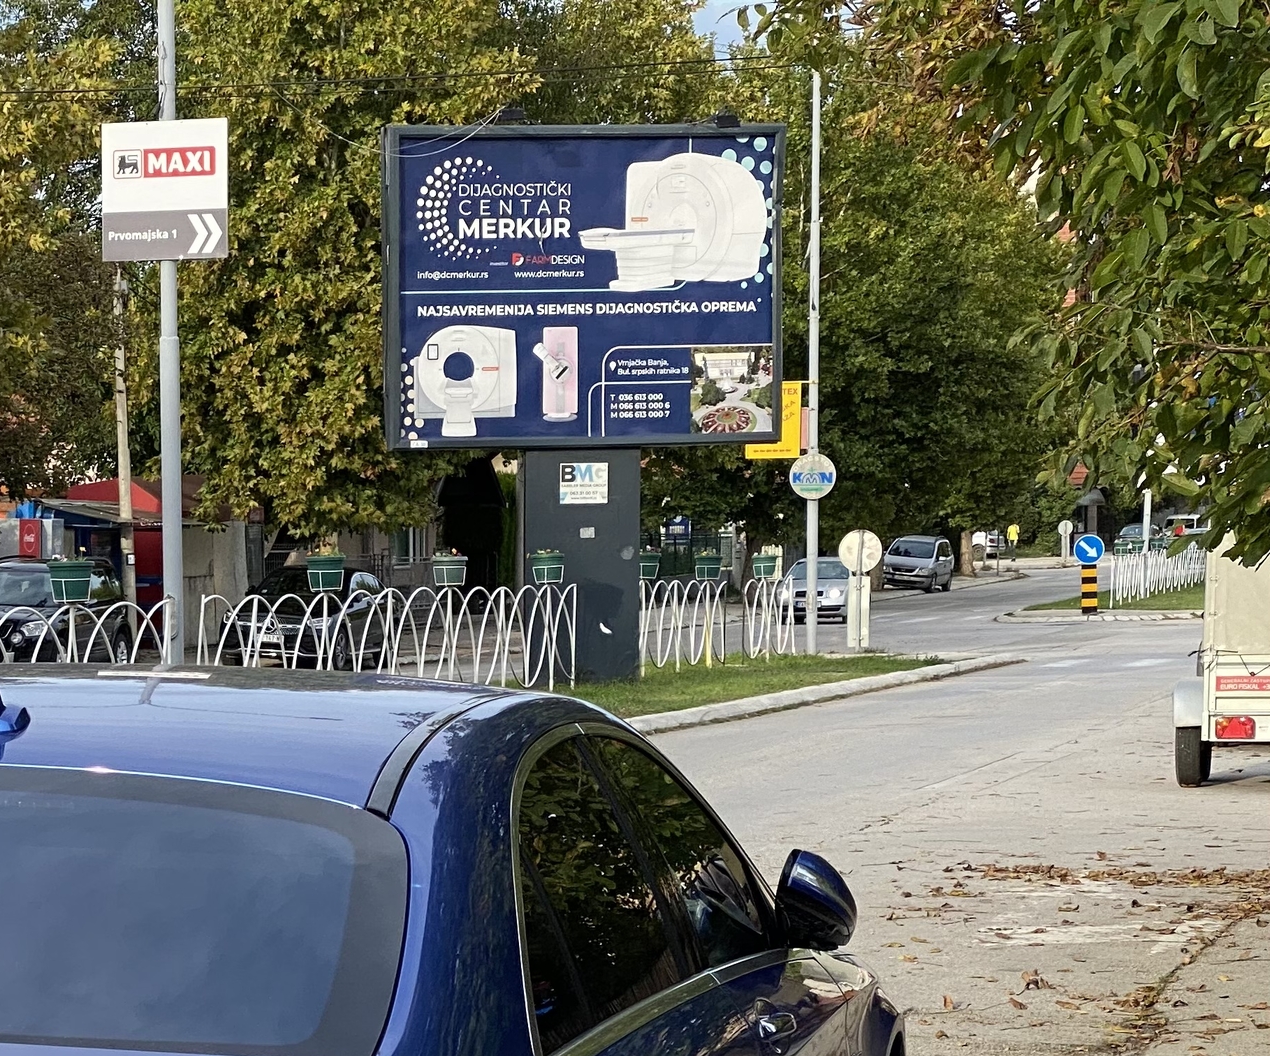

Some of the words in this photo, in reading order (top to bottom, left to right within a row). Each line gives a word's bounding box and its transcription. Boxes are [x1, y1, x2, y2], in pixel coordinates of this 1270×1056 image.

[148, 150, 211, 174] MAXI
[459, 181, 572, 197] DIJAGNOSTIČKI
[459, 199, 572, 216] CENTAR
[459, 218, 572, 239] MERKUR
[108, 228, 169, 243] Prvomajska
[172, 229, 178, 239] 1
[417, 270, 489, 280] info@dcmerkur.rs
[514, 269, 585, 279] www.dcmerkur.rs
[417, 304, 535, 318] NAJSAVREMENIJA
[536, 302, 594, 317] SIEMENS
[596, 299, 699, 316] DIJAGNOSTIČKA
[700, 300, 757, 314] OPREMA
[681, 366, 689, 374] 18
[618, 393, 633, 401] 036
[634, 393, 647, 401] 613
[648, 393, 663, 401] 000
[618, 402, 633, 410] 066
[634, 402, 647, 410] 613
[610, 411, 618, 419] M
[618, 411, 633, 419] 066
[664, 410, 670, 418] 7
